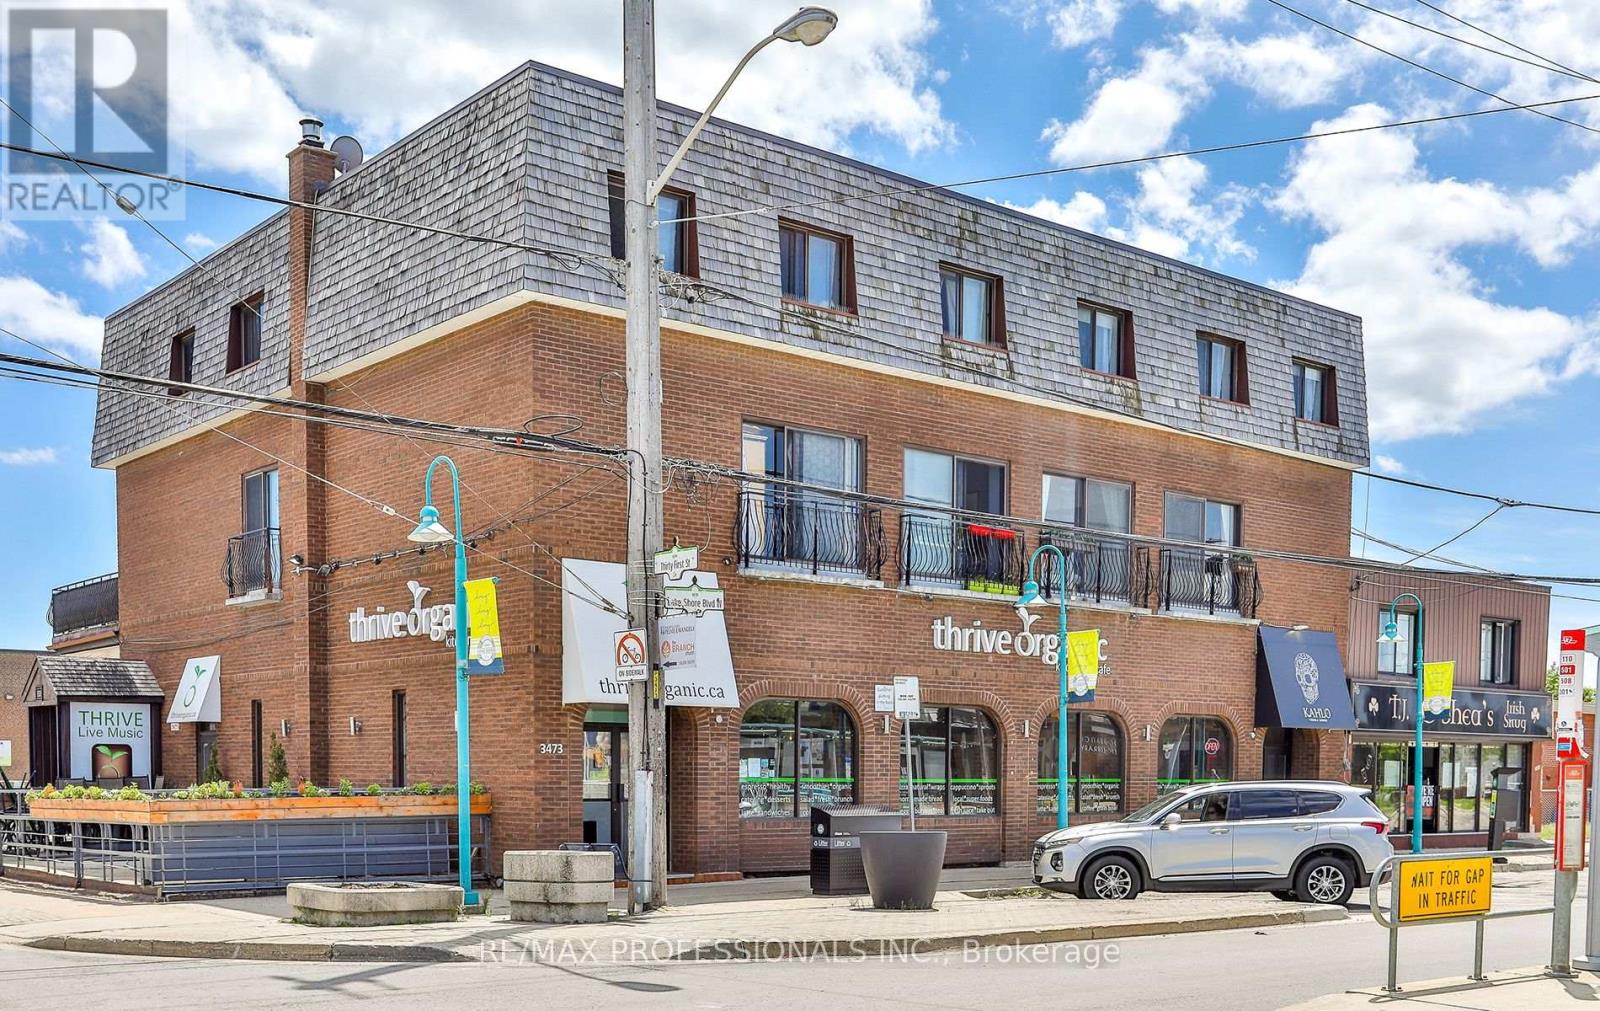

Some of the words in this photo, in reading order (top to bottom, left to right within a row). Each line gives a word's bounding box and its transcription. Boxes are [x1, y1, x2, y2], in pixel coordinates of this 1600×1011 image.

[661, 561, 673, 572] Thirty
[674, 559, 684, 569] First
[685, 558, 691, 568] St
[684, 598, 701, 607] Shore
[703, 598, 715, 608] Blvd
[349, 606, 407, 643] thrive
[931, 616, 1012, 655] thrive
[1303, 707, 1331, 719] KAHLO
[1506, 700, 1525, 715] Irish
[78, 711, 144, 727] THRIVE
[1503, 714, 1527, 733] Snug
[78, 727, 104, 738] Live
[107, 727, 144, 739] Music
[540, 743, 563, 754] 3473
[1411, 871, 1435, 888] WAIT
[1440, 870, 1460, 886] FOR
[1466, 868, 1485, 884] GAP
[1418, 893, 1429, 909] IN
[1435, 889, 1477, 908] TRAFFIC
